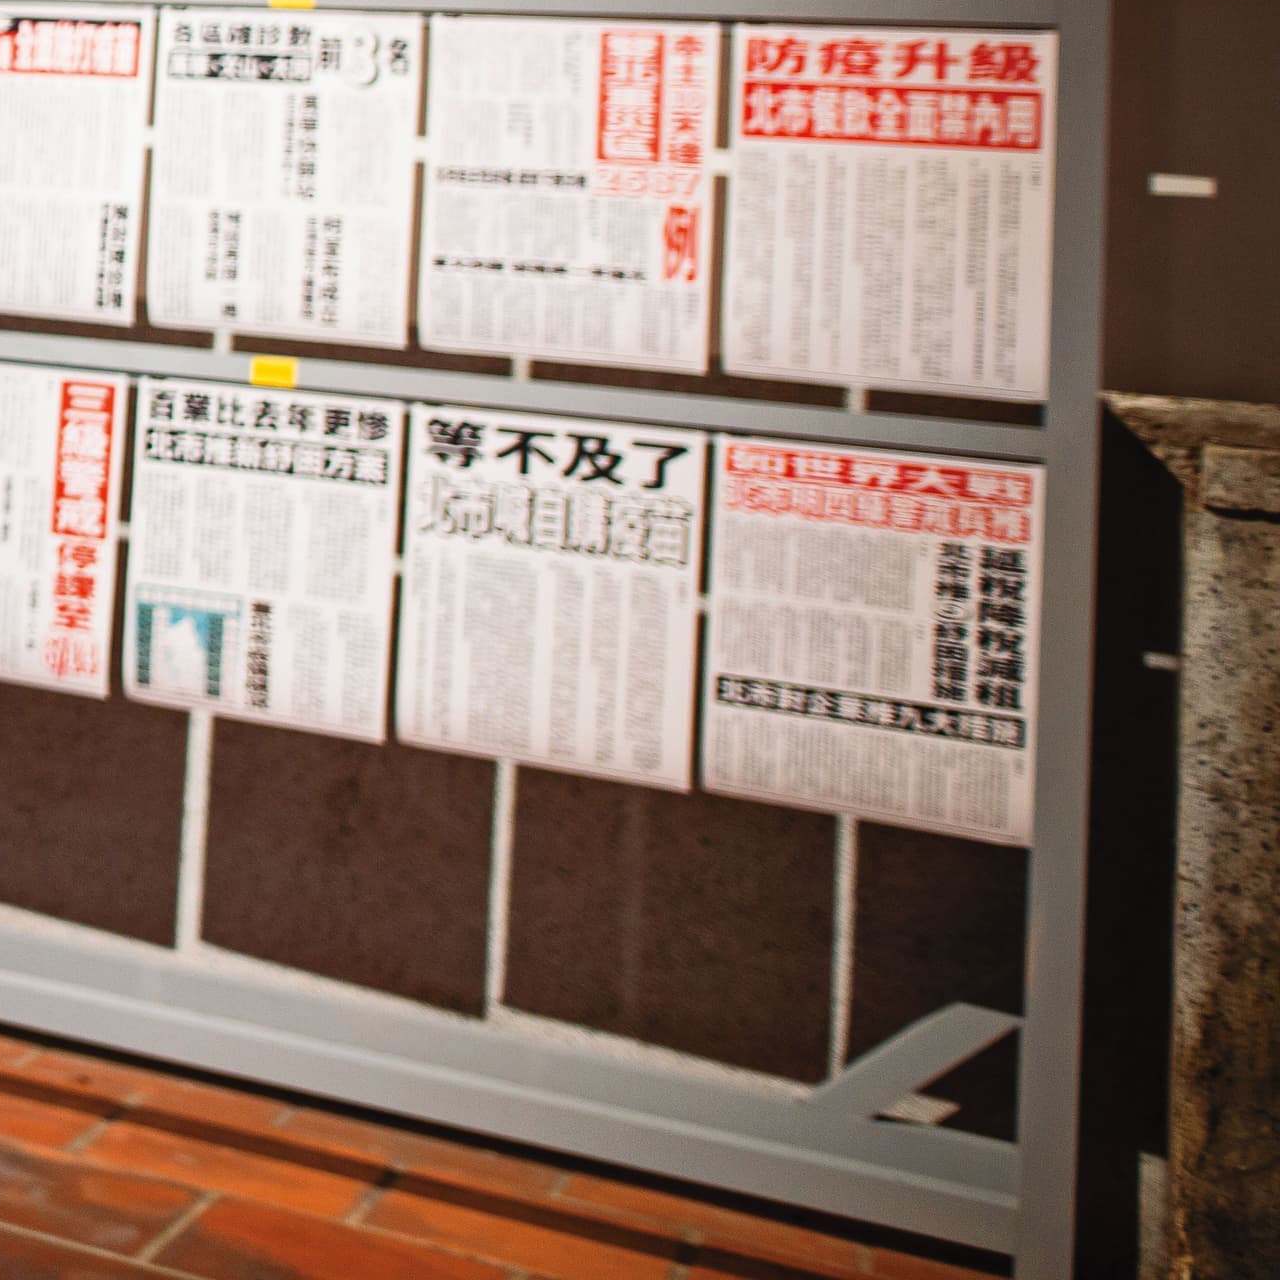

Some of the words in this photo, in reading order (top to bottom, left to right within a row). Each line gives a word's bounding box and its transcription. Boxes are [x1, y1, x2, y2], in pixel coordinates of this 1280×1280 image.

[745, 35, 1039, 83] 防疫升級
[149, 389, 390, 440] 百業比去年更慘
[427, 417, 689, 490] 等不及了
